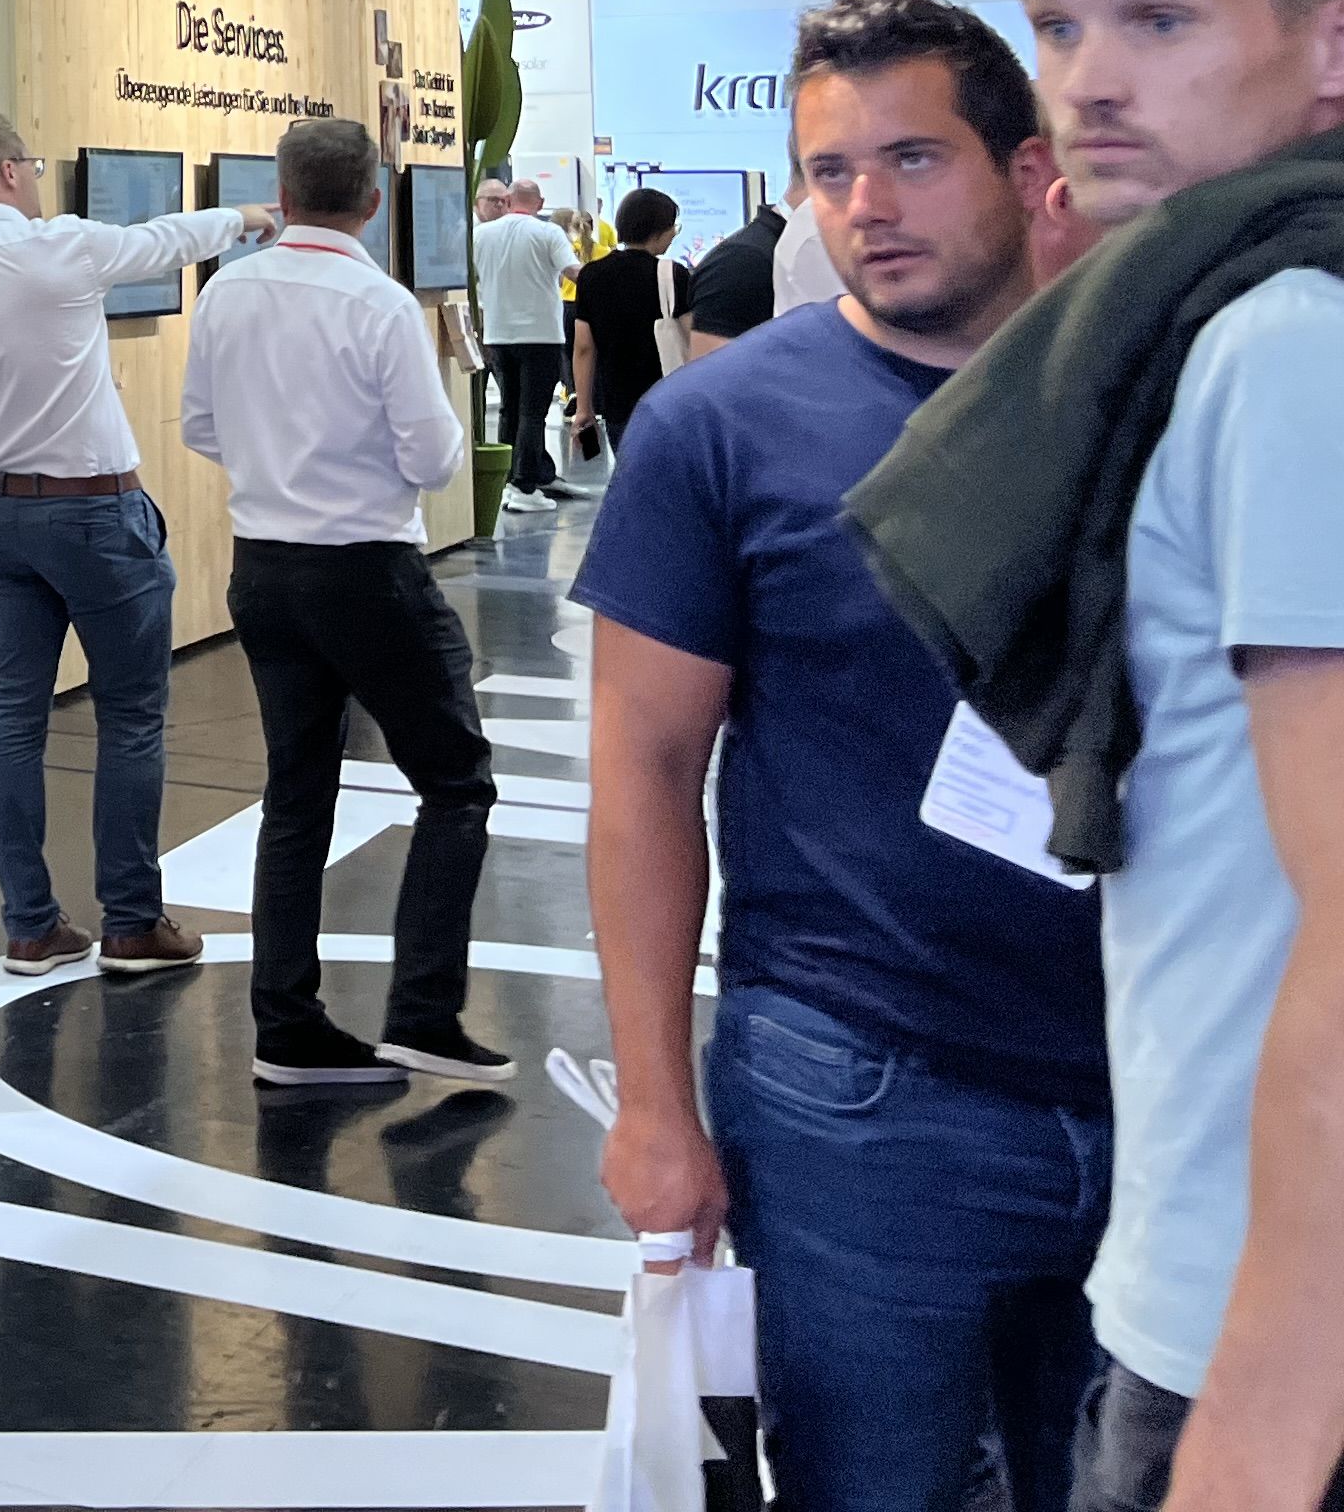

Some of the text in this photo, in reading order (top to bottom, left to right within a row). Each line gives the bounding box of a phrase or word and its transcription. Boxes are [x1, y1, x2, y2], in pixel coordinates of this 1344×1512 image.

[176, 0, 289, 64] Die Services.
[694, 64, 789, 111] kra
